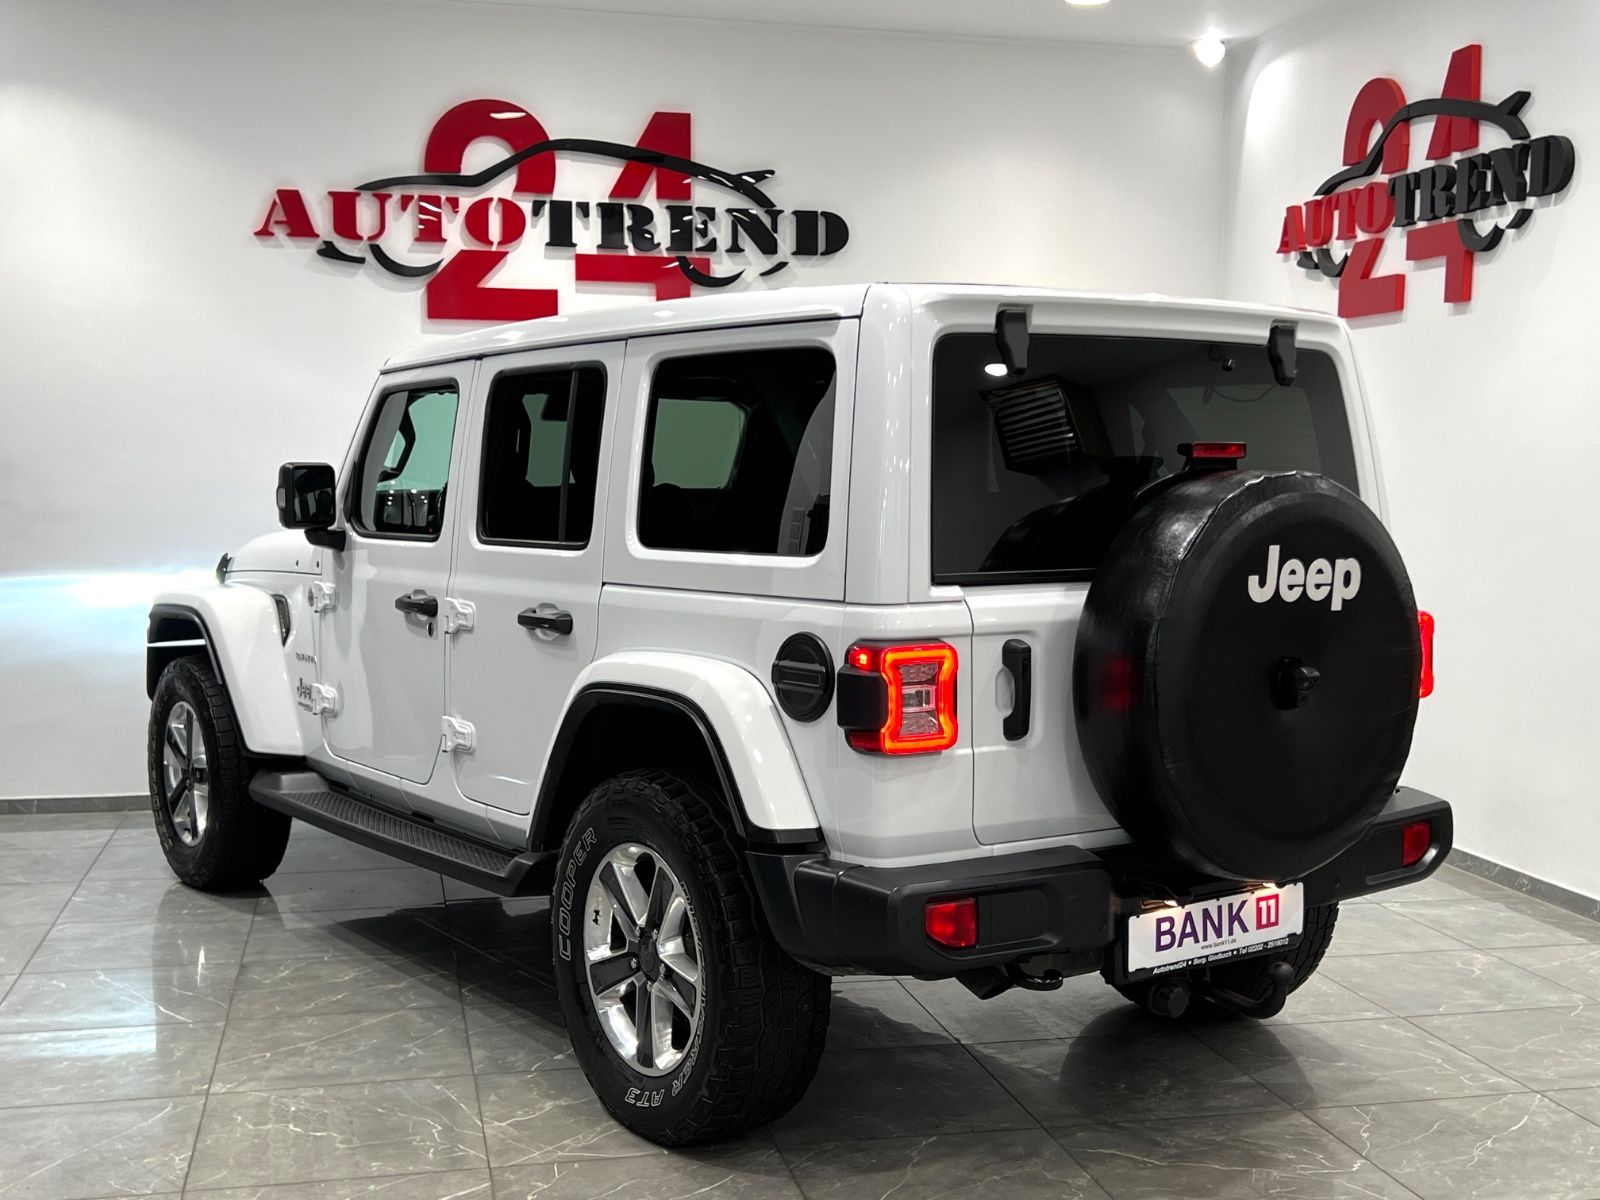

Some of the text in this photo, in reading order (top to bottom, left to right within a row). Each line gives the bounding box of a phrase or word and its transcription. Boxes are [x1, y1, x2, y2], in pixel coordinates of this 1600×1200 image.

[424, 98, 711, 321] 24
[1338, 44, 1482, 318] 24
[1248, 544, 1361, 611] Jeep
[559, 827, 598, 961] COOPER
[1155, 899, 1249, 953] BANK
[624, 1087, 665, 1107] AT3
